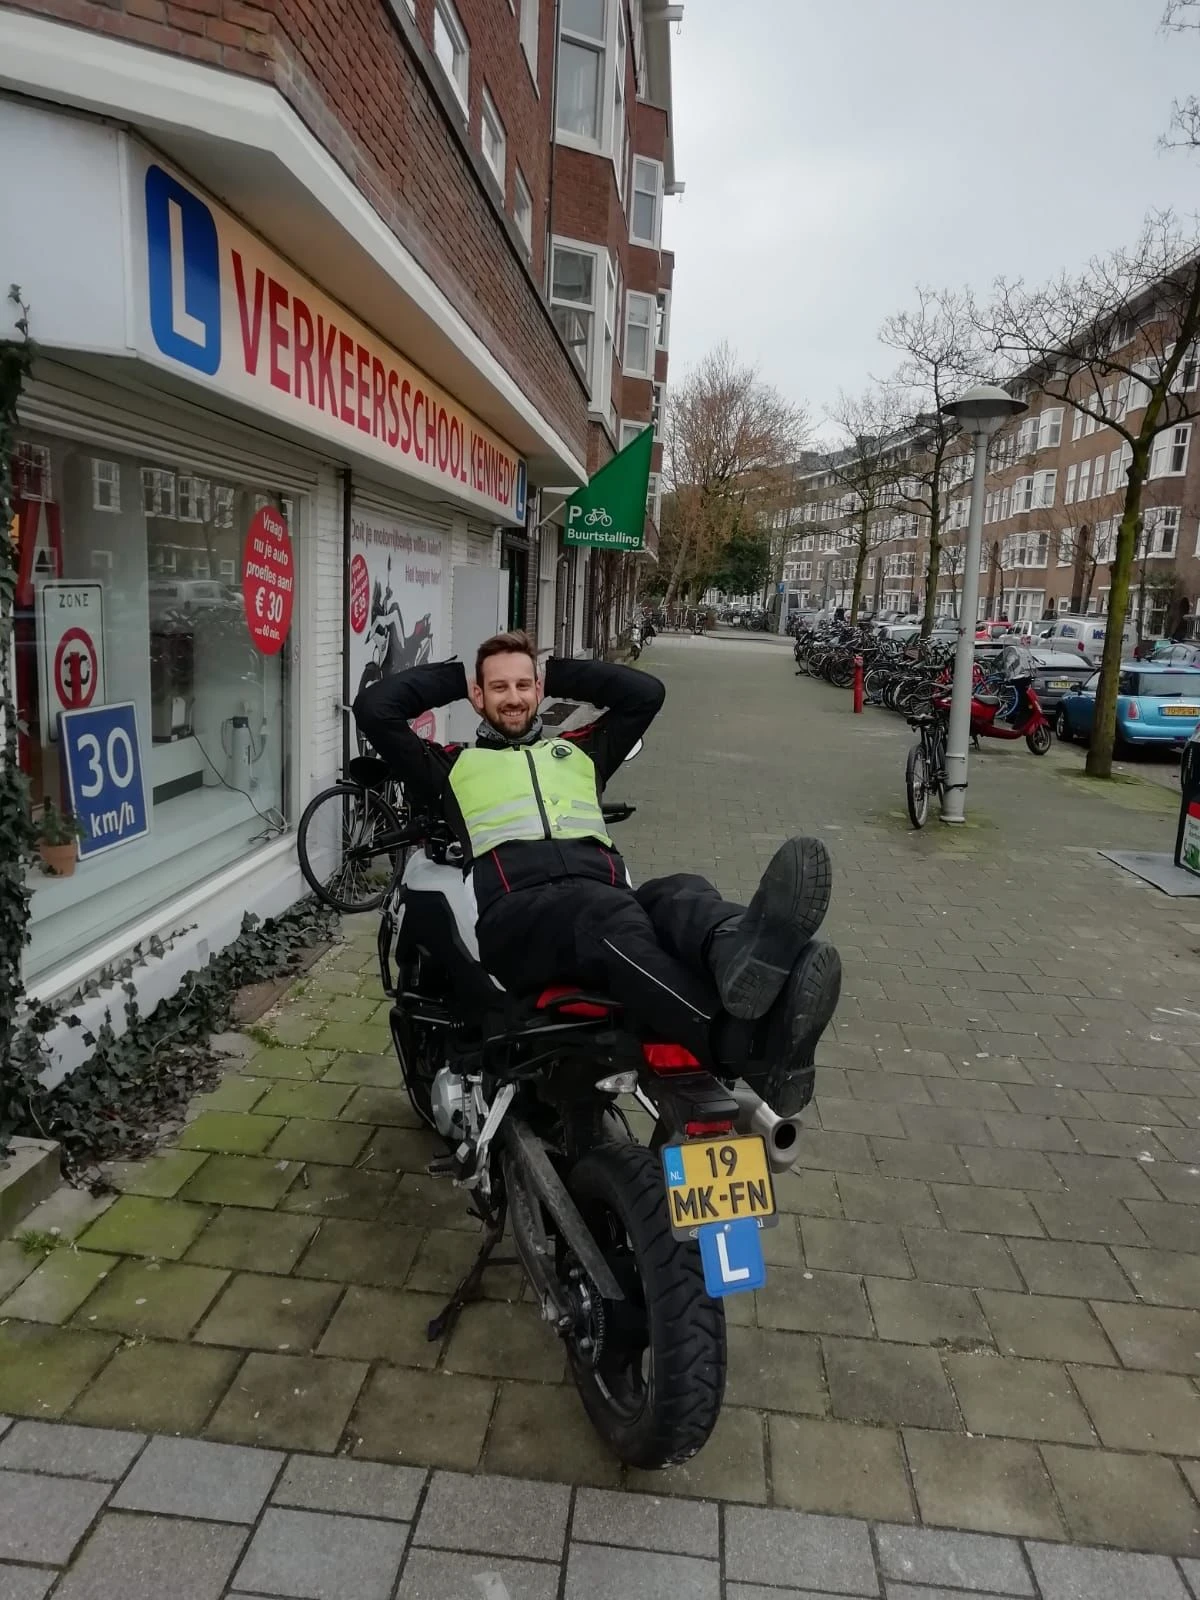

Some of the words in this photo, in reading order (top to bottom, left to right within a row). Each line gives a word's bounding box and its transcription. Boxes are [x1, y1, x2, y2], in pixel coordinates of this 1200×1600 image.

[168, 198, 206, 349] L
[231, 249, 467, 482] VERKEERSSCHOOL
[470, 430, 515, 508] KENNEDY
[263, 512, 283, 541] Vraag
[568, 505, 582, 524] P
[253, 537, 264, 554] nu
[264, 540, 272, 560] je
[272, 548, 289, 566] auto
[567, 528, 640, 547] Buurtstalling
[246, 561, 276, 586] proefles
[277, 574, 292, 592] aan!
[59, 593, 89, 609] ZONE
[255, 586, 266, 617] €
[267, 591, 283, 623] 30
[262, 624, 270, 637] 60
[269, 628, 280, 640] min.
[77, 727, 134, 798] 30
[90, 801, 135, 838] km/h
[670, 1171, 683, 1181] NL
[705, 1146, 738, 1178] 19
[673, 1179, 768, 1222] MK-FN
[715, 1232, 749, 1283] L
